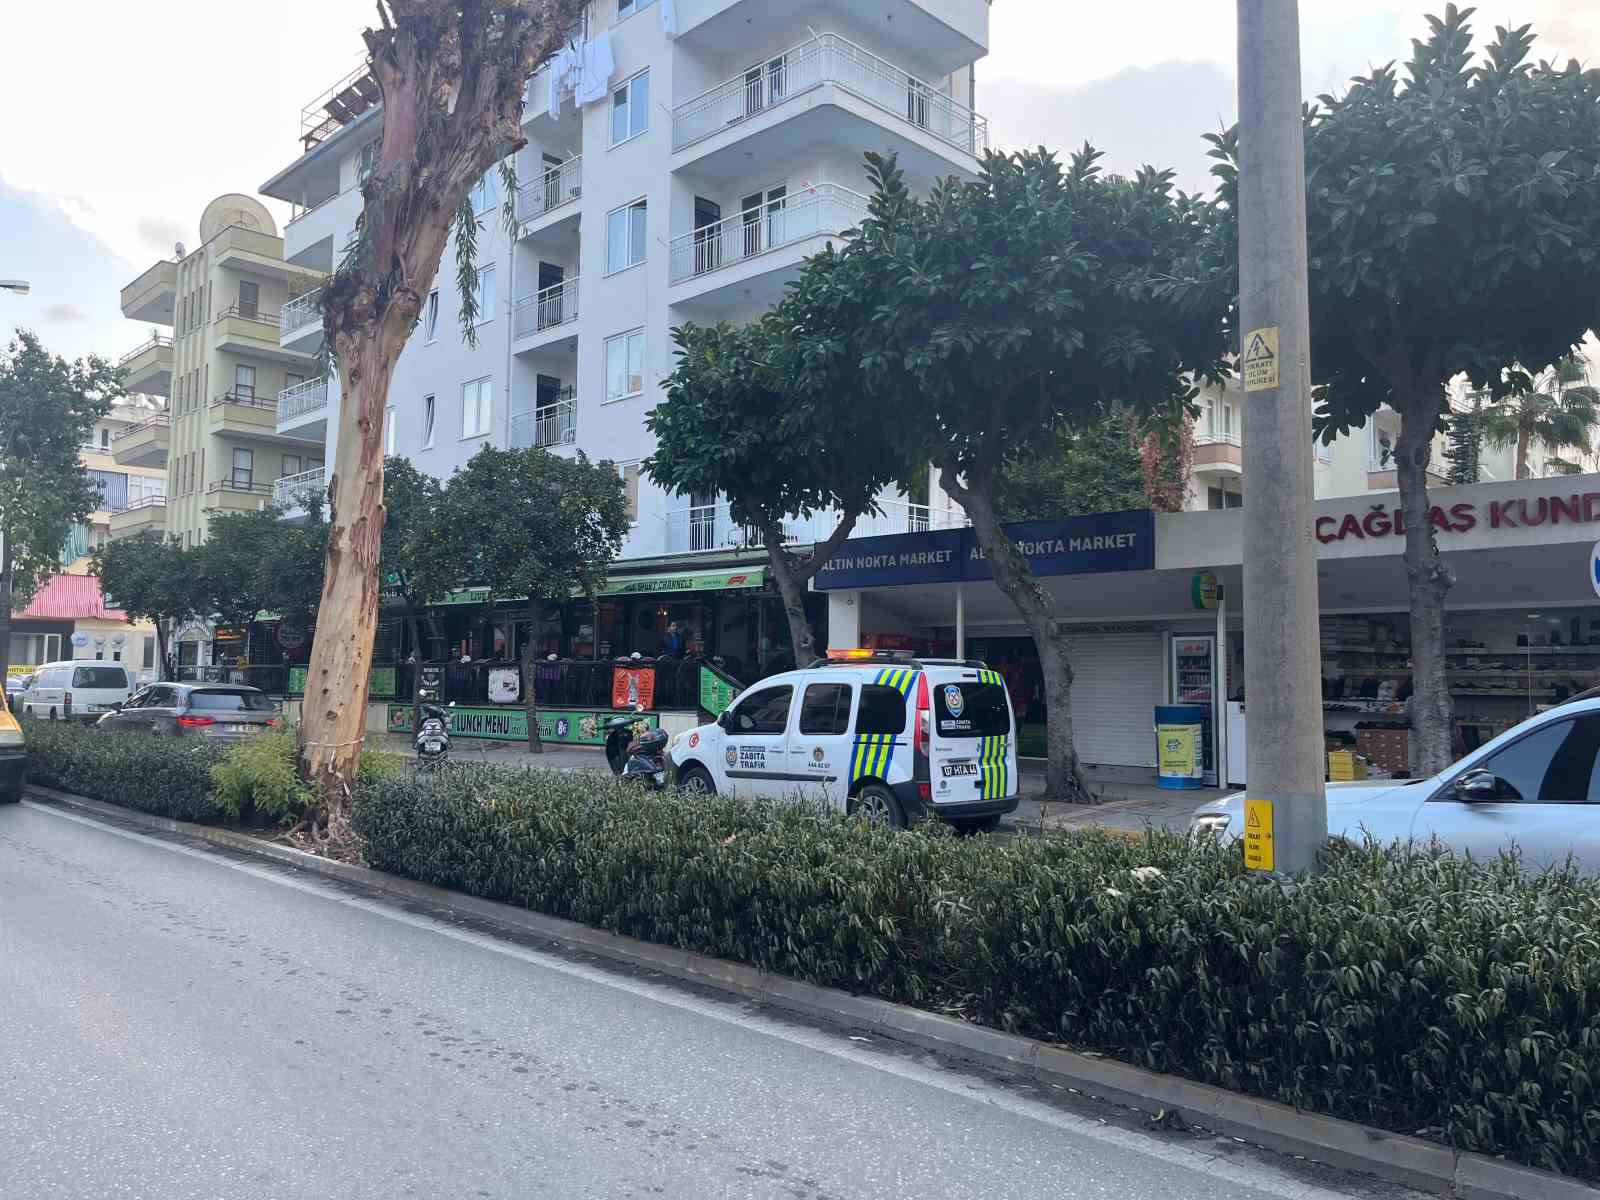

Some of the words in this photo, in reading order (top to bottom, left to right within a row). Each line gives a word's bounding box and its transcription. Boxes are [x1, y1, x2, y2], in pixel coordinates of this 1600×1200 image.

[1069, 533, 1136, 552] MARKET
[821, 558, 854, 571] ALTIN
[857, 555, 897, 569] NOKTA
[900, 550, 953, 567] MARKET
[456, 713, 481, 732] LUNCH
[485, 714, 510, 734] MENU
[740, 752, 765, 760] ZABITA
